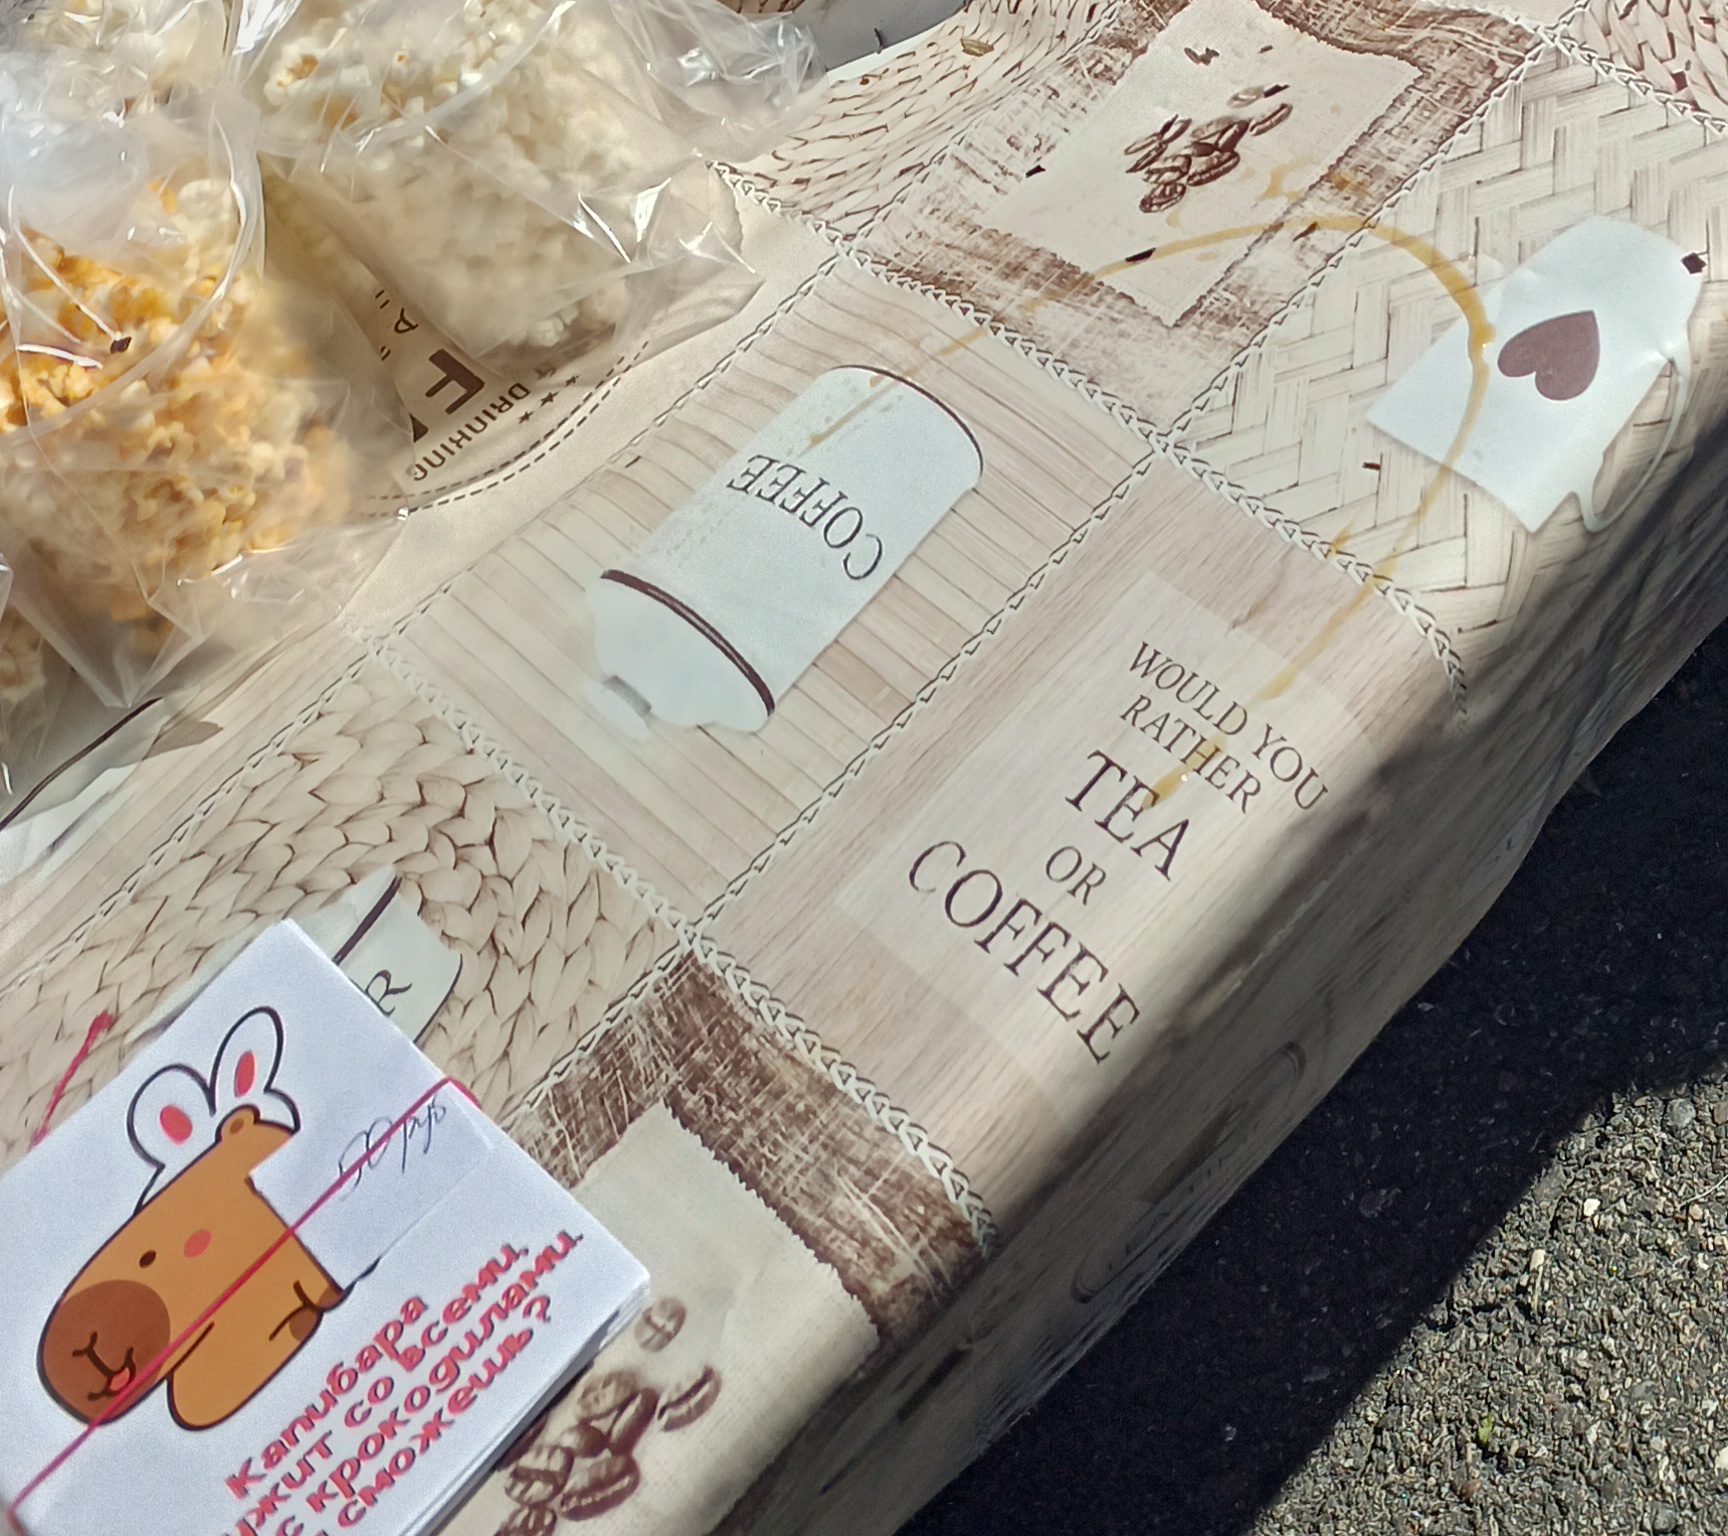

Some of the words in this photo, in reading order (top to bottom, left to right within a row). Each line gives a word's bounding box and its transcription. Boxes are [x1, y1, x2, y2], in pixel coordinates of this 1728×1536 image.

[726, 454, 884, 580] COFFEE
[1119, 694, 1263, 815] RATHER
[1128, 640, 1249, 737] WOULD
[1250, 723, 1330, 811] YOU
[1044, 845, 1108, 906] OR
[1064, 749, 1192, 882] TEA
[907, 839, 1141, 1064] COFFEE
[224, 1295, 429, 1501] Капибара
[343, 1375, 395, 1429] со
